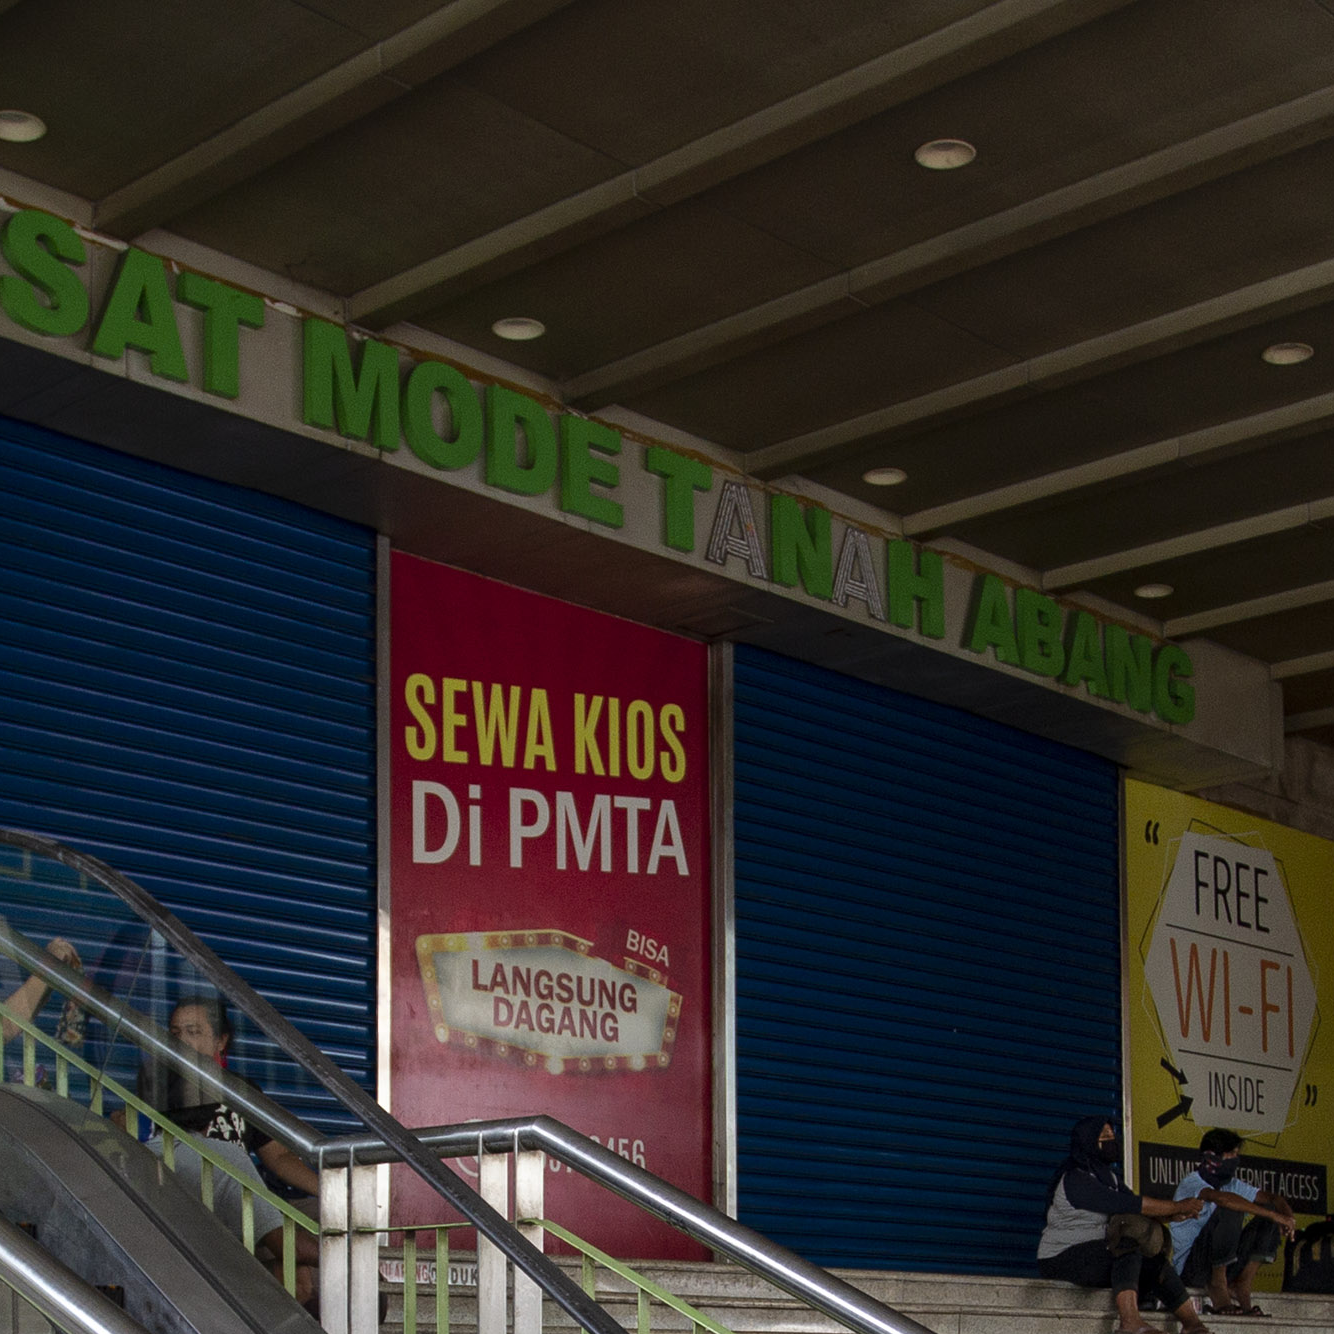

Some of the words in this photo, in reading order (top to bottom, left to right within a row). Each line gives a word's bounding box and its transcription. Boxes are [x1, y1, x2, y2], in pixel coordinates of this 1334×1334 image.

[302, 318, 624, 530] MODE
[645, 444, 947, 640] TANAH
[966, 573, 1196, 726] ABANG
[404, 673, 556, 772] SEWA
[573, 692, 687, 783] KIOS
[411, 779, 481, 867] Di
[510, 787, 689, 876] PMTA
[1194, 849, 1270, 933] FREE
[626, 929, 669, 967] BISA
[471, 959, 637, 1010] LANGSUNG
[1170, 937, 1294, 1058] WI-FI
[493, 995, 619, 1042] DAGANG
[1208, 1071, 1265, 1116] INSIDE
[1278, 1171, 1320, 1201] ACCESS
